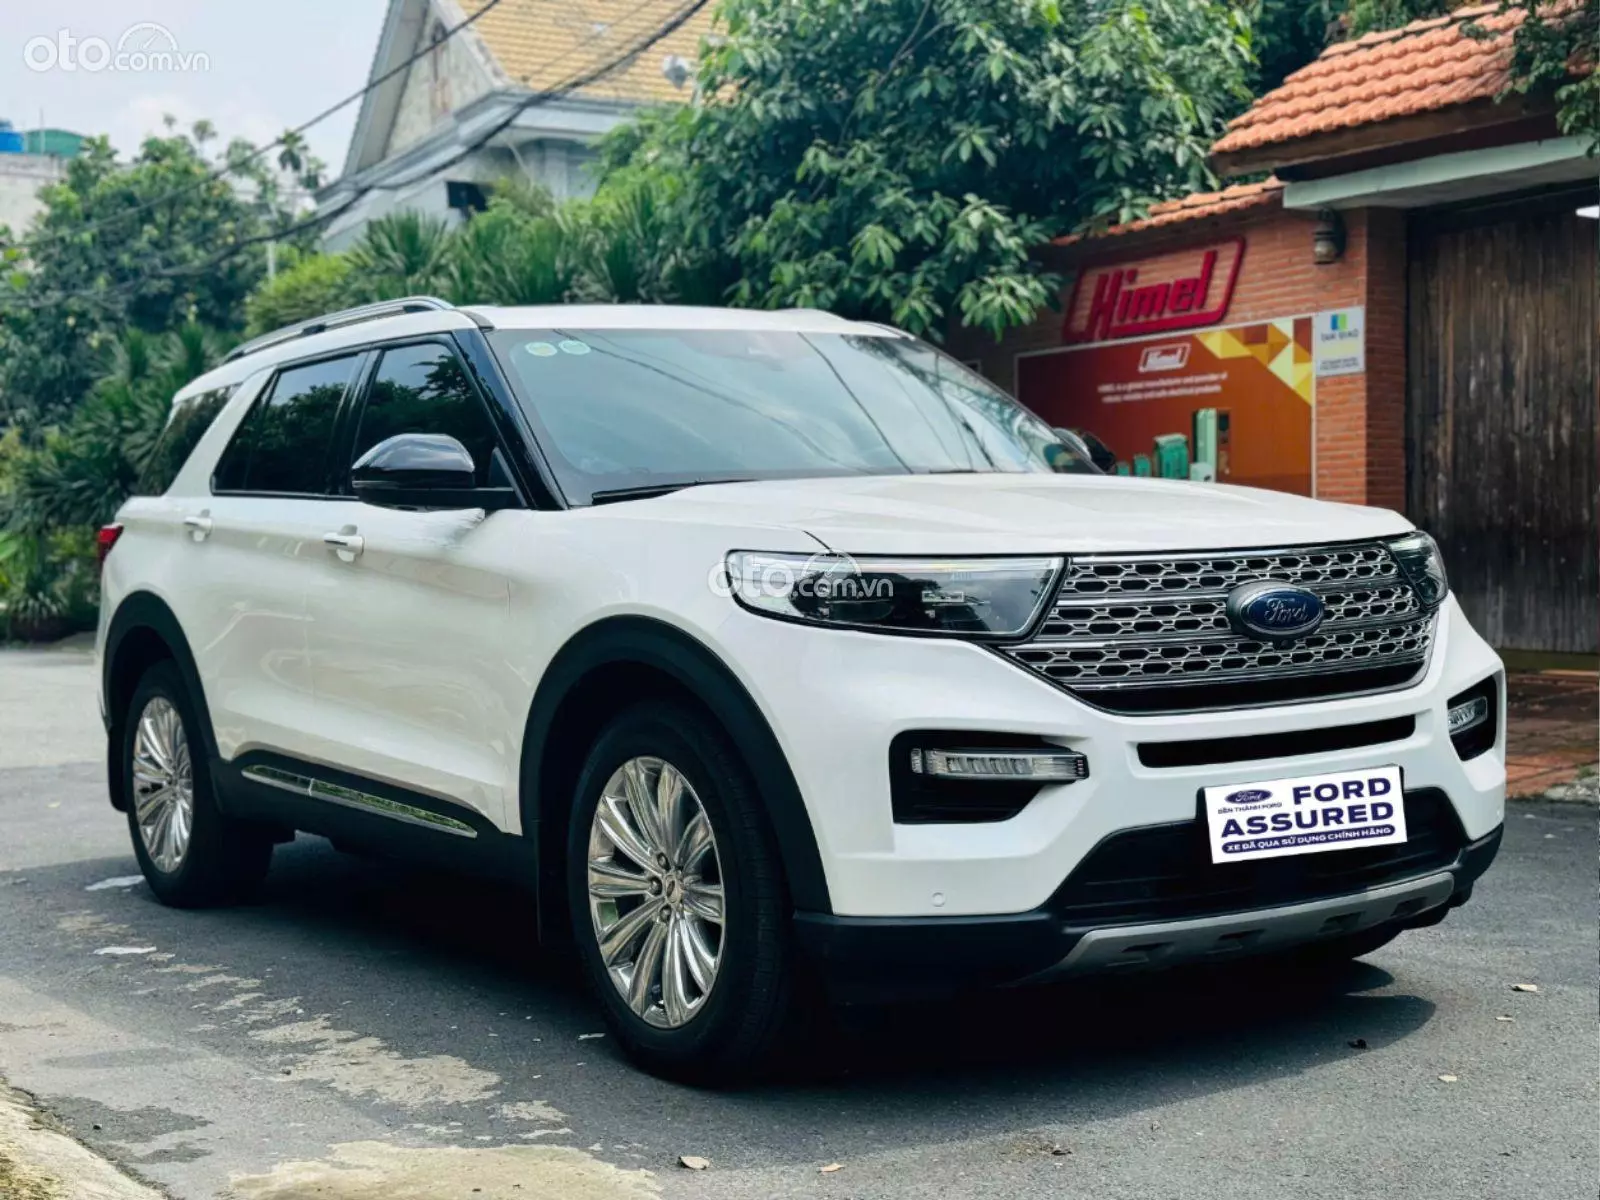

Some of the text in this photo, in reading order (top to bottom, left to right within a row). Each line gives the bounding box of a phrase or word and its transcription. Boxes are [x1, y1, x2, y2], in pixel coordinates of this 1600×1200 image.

[1084, 250, 1218, 340] Himel
[1263, 597, 1309, 623] Ford
[1235, 791, 1262, 802] Ford
[1292, 777, 1391, 805] FORD
[1221, 802, 1393, 838] ASSURED
[1226, 842, 1240, 852] XE
[1257, 839, 1280, 849] QUA
